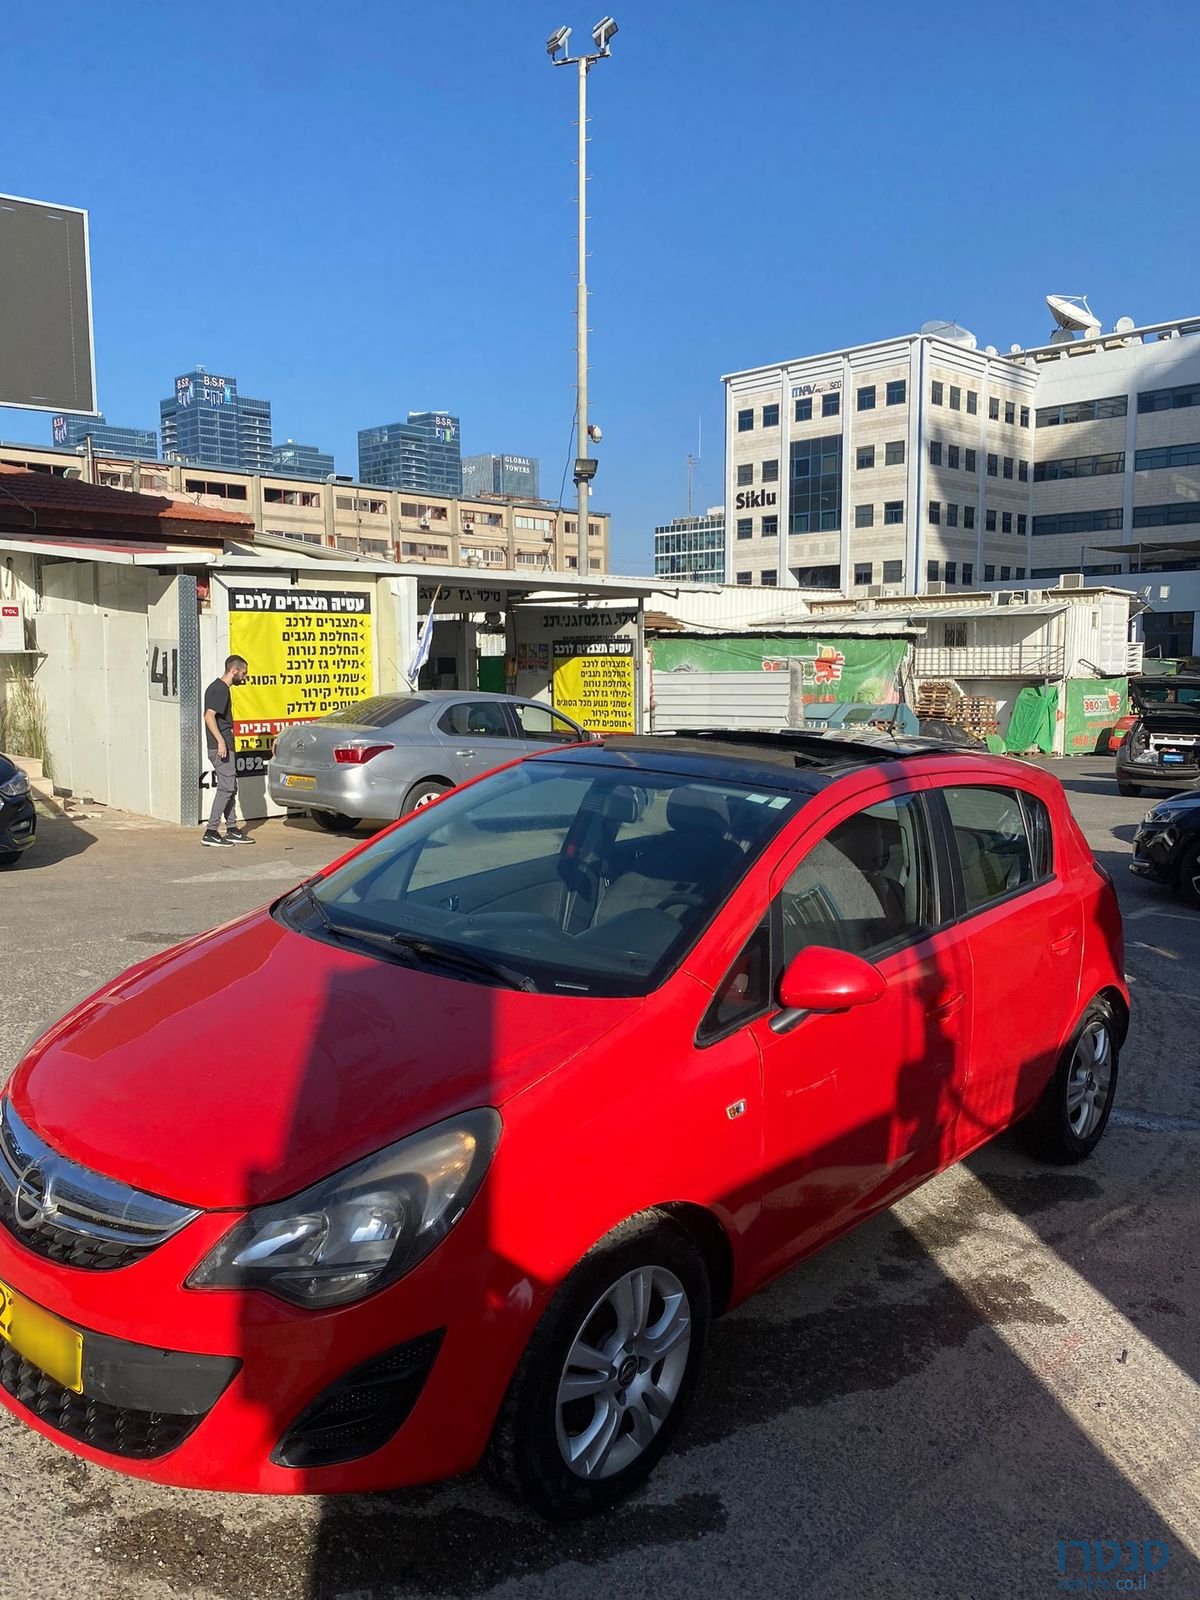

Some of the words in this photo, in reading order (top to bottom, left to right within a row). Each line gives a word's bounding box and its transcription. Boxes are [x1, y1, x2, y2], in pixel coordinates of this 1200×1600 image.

[504, 455, 531, 466] GLOBAL
[505, 464, 531, 474] TOWERS
[735, 489, 776, 510] Siklu
[235, 593, 271, 609] לרכב
[275, 595, 328, 611] מצברים
[331, 597, 365, 612] עטיה
[285, 616, 312, 628] לרכב
[316, 617, 358, 628] מצברים
[282, 631, 315, 642] מגבים
[320, 630, 359, 641] החלפת
[287, 645, 316, 656] נורות
[320, 644, 359, 655] החלפת
[554, 643, 574, 655] לרכב
[286, 658, 314, 670] לרכב
[318, 660, 329, 670] גז
[332, 657, 359, 669] מילוי
[582, 659, 598, 668] לרכב
[600, 660, 626, 668] מצברים
[280, 672, 302, 684] מכל
[305, 674, 330, 684] מנוע
[333, 673, 359, 683] שמני
[602, 669, 626, 678] החלפת
[301, 687, 331, 699] קירור
[335, 685, 359, 696] נוזלי
[583, 689, 599, 697] לרכב
[610, 689, 627, 697] מילוי
[287, 699, 316, 715] לדלק
[320, 700, 358, 711] ספים
[579, 699, 592, 707] מכל
[610, 700, 627, 708] שמני
[239, 722, 271, 734] הבית
[583, 718, 600, 728] לדלק
